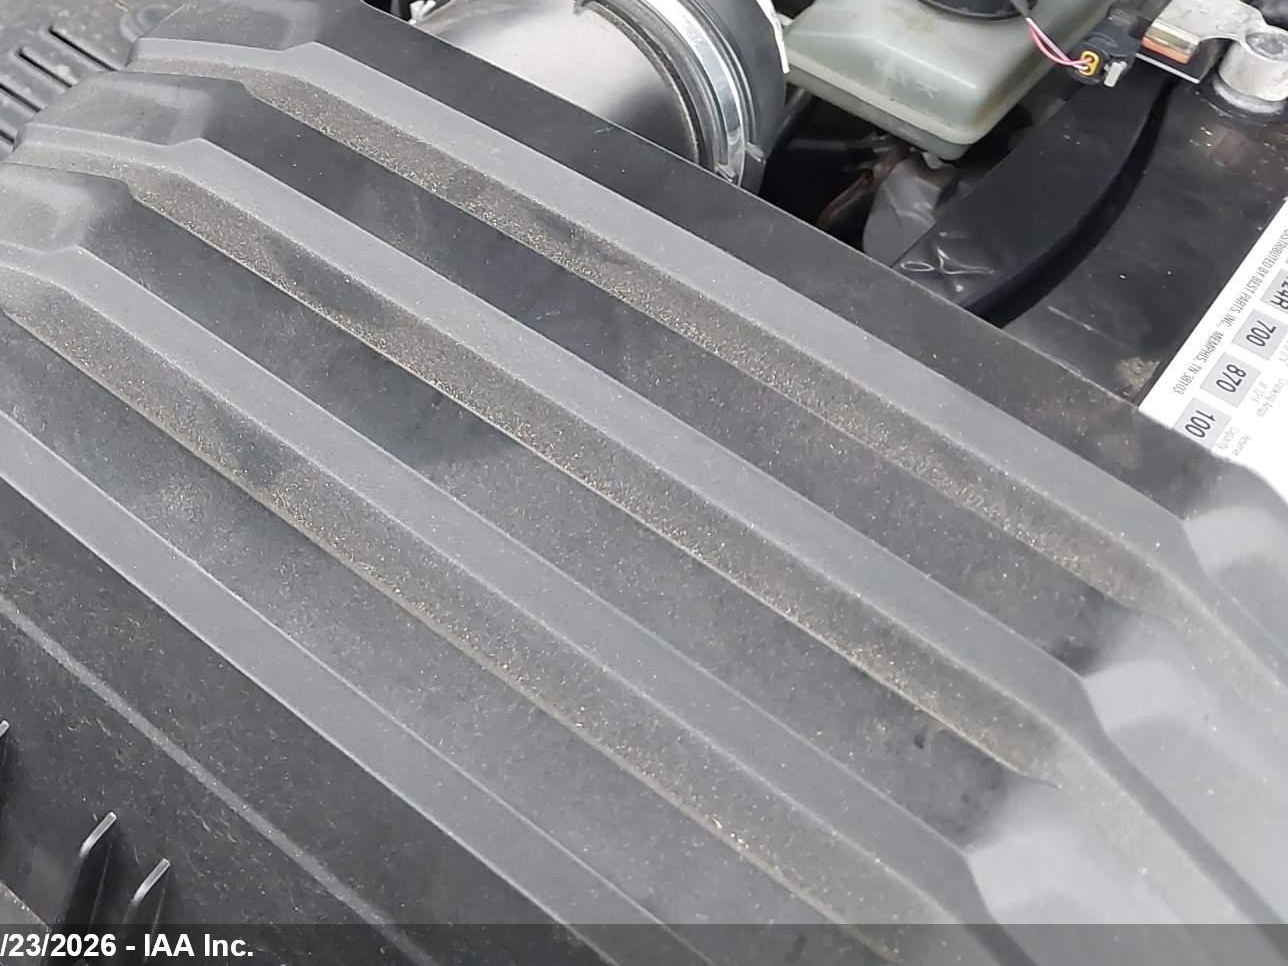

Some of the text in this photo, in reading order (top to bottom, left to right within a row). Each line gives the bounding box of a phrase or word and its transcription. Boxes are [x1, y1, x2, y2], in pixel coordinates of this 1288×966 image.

[1255, 266, 1269, 278] BY
[1245, 275, 1263, 294] BEST
[1246, 319, 1277, 347] 700
[1188, 363, 1202, 375] TN
[1215, 364, 1247, 393] 870
[1173, 372, 1195, 394] 38103
[1185, 409, 1216, 438] 100
